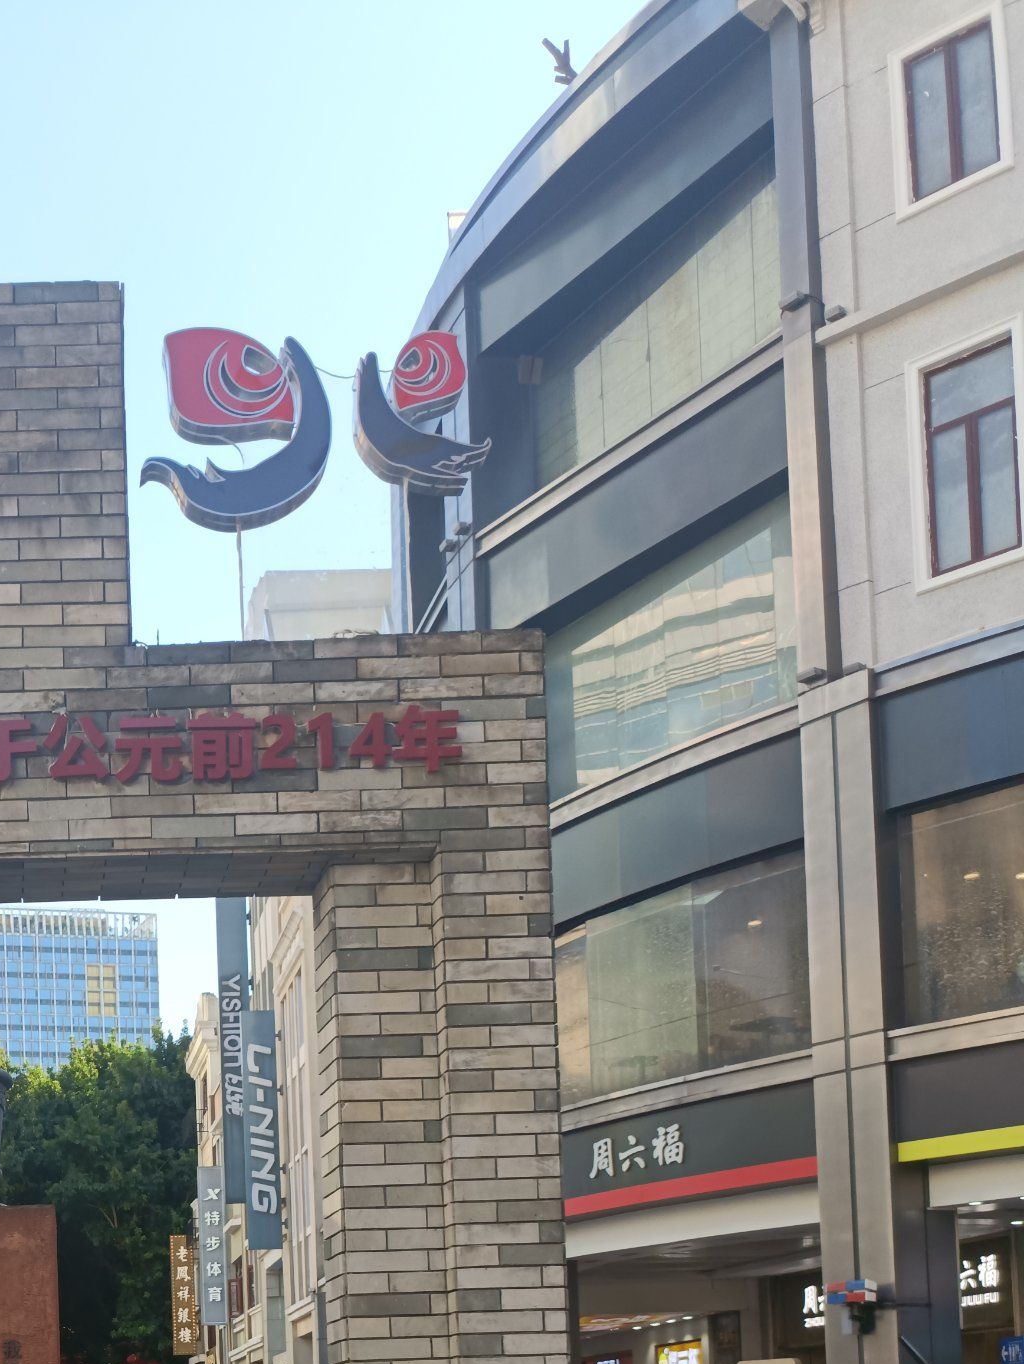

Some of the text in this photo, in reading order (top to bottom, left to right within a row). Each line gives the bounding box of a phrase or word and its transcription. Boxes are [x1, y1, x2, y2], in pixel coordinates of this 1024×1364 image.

[247, 1043, 278, 1215] LI-NING
[589, 1123, 684, 1179] 周六福
[204, 1210, 223, 1302] 特步体育
